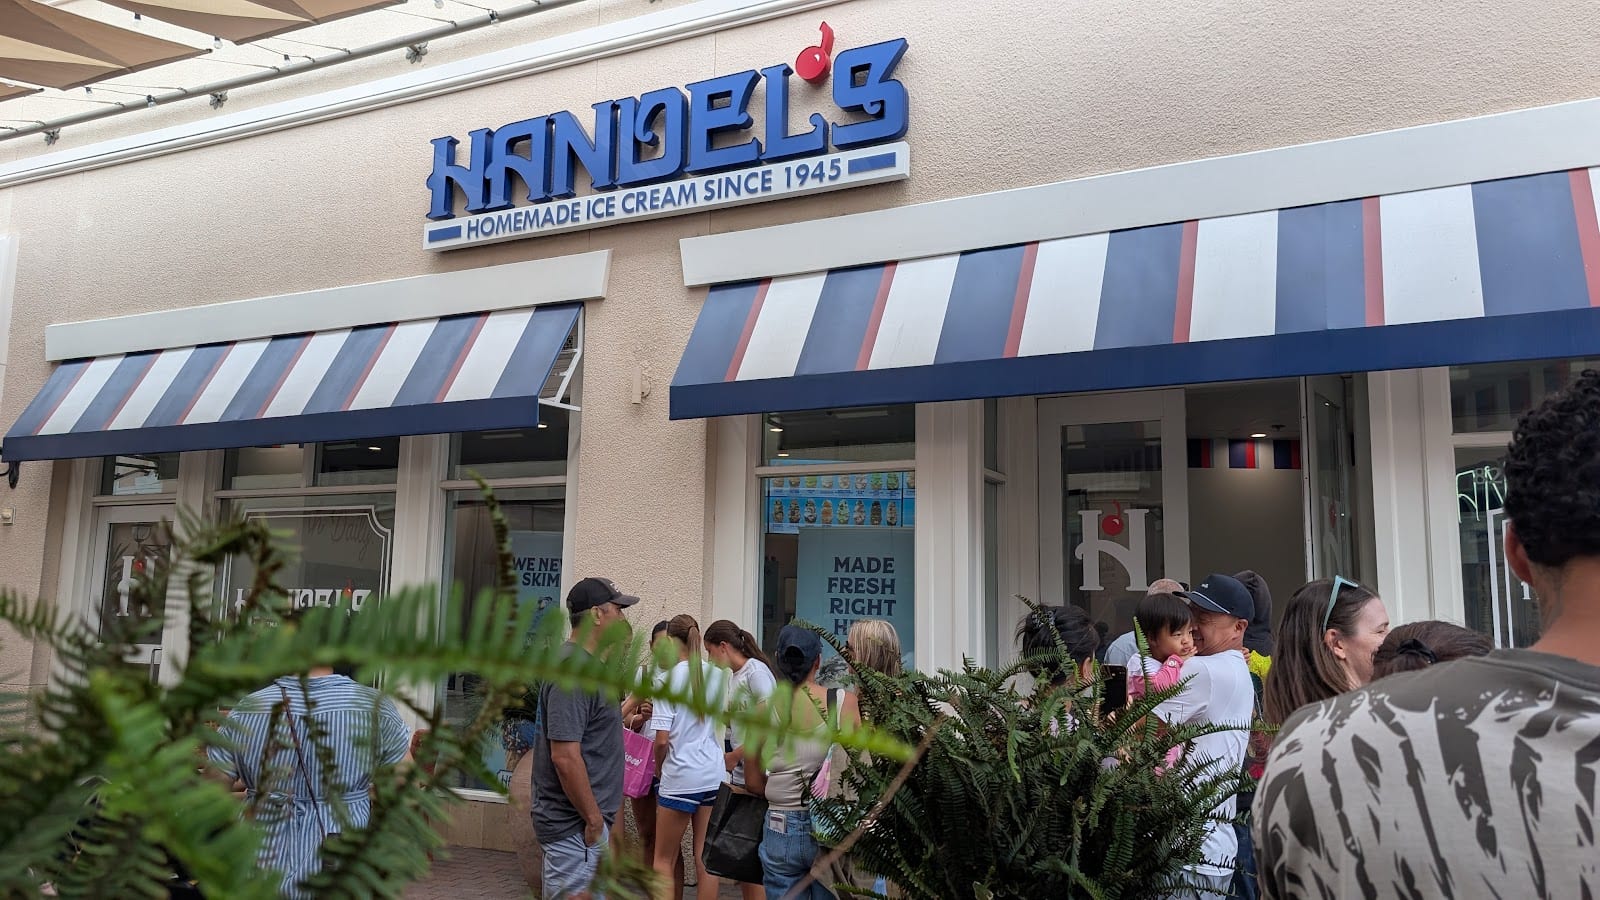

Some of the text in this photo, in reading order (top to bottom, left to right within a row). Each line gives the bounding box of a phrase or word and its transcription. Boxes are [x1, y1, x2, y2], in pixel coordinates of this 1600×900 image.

[426, 21, 909, 220] HANDEL'S
[466, 158, 842, 240] HOMEMADE ICE CREAM SINCE 1945
[512, 557, 536, 571] WE
[833, 556, 895, 574] MADE
[827, 577, 896, 595] FRESH
[830, 597, 897, 617] RIGHT
